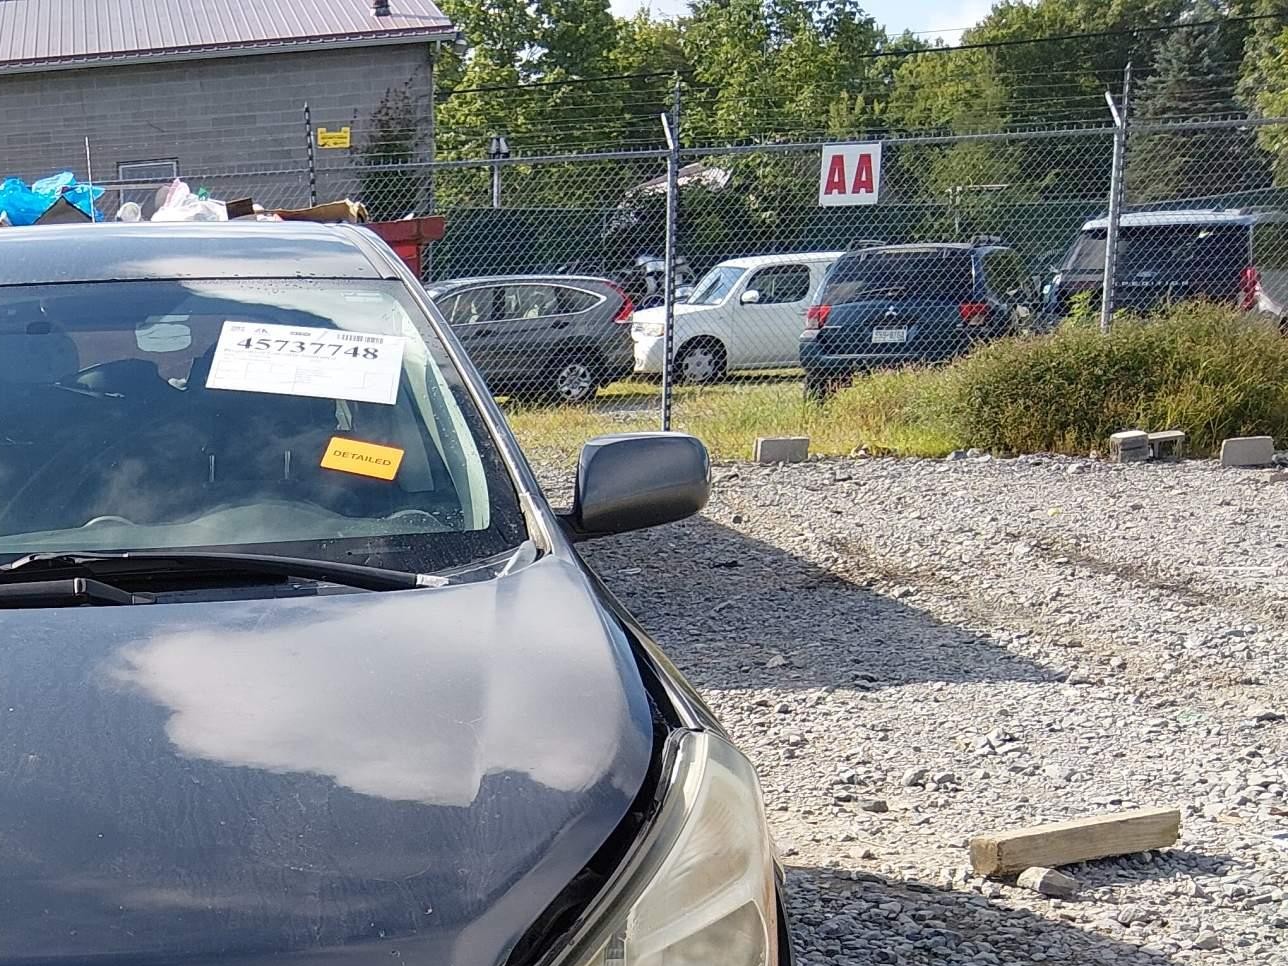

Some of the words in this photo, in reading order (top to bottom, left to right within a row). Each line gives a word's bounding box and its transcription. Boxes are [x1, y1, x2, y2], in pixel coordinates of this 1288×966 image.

[824, 154, 874, 195] AA
[237, 336, 379, 360] 45737748
[333, 449, 392, 466] DETAILED
